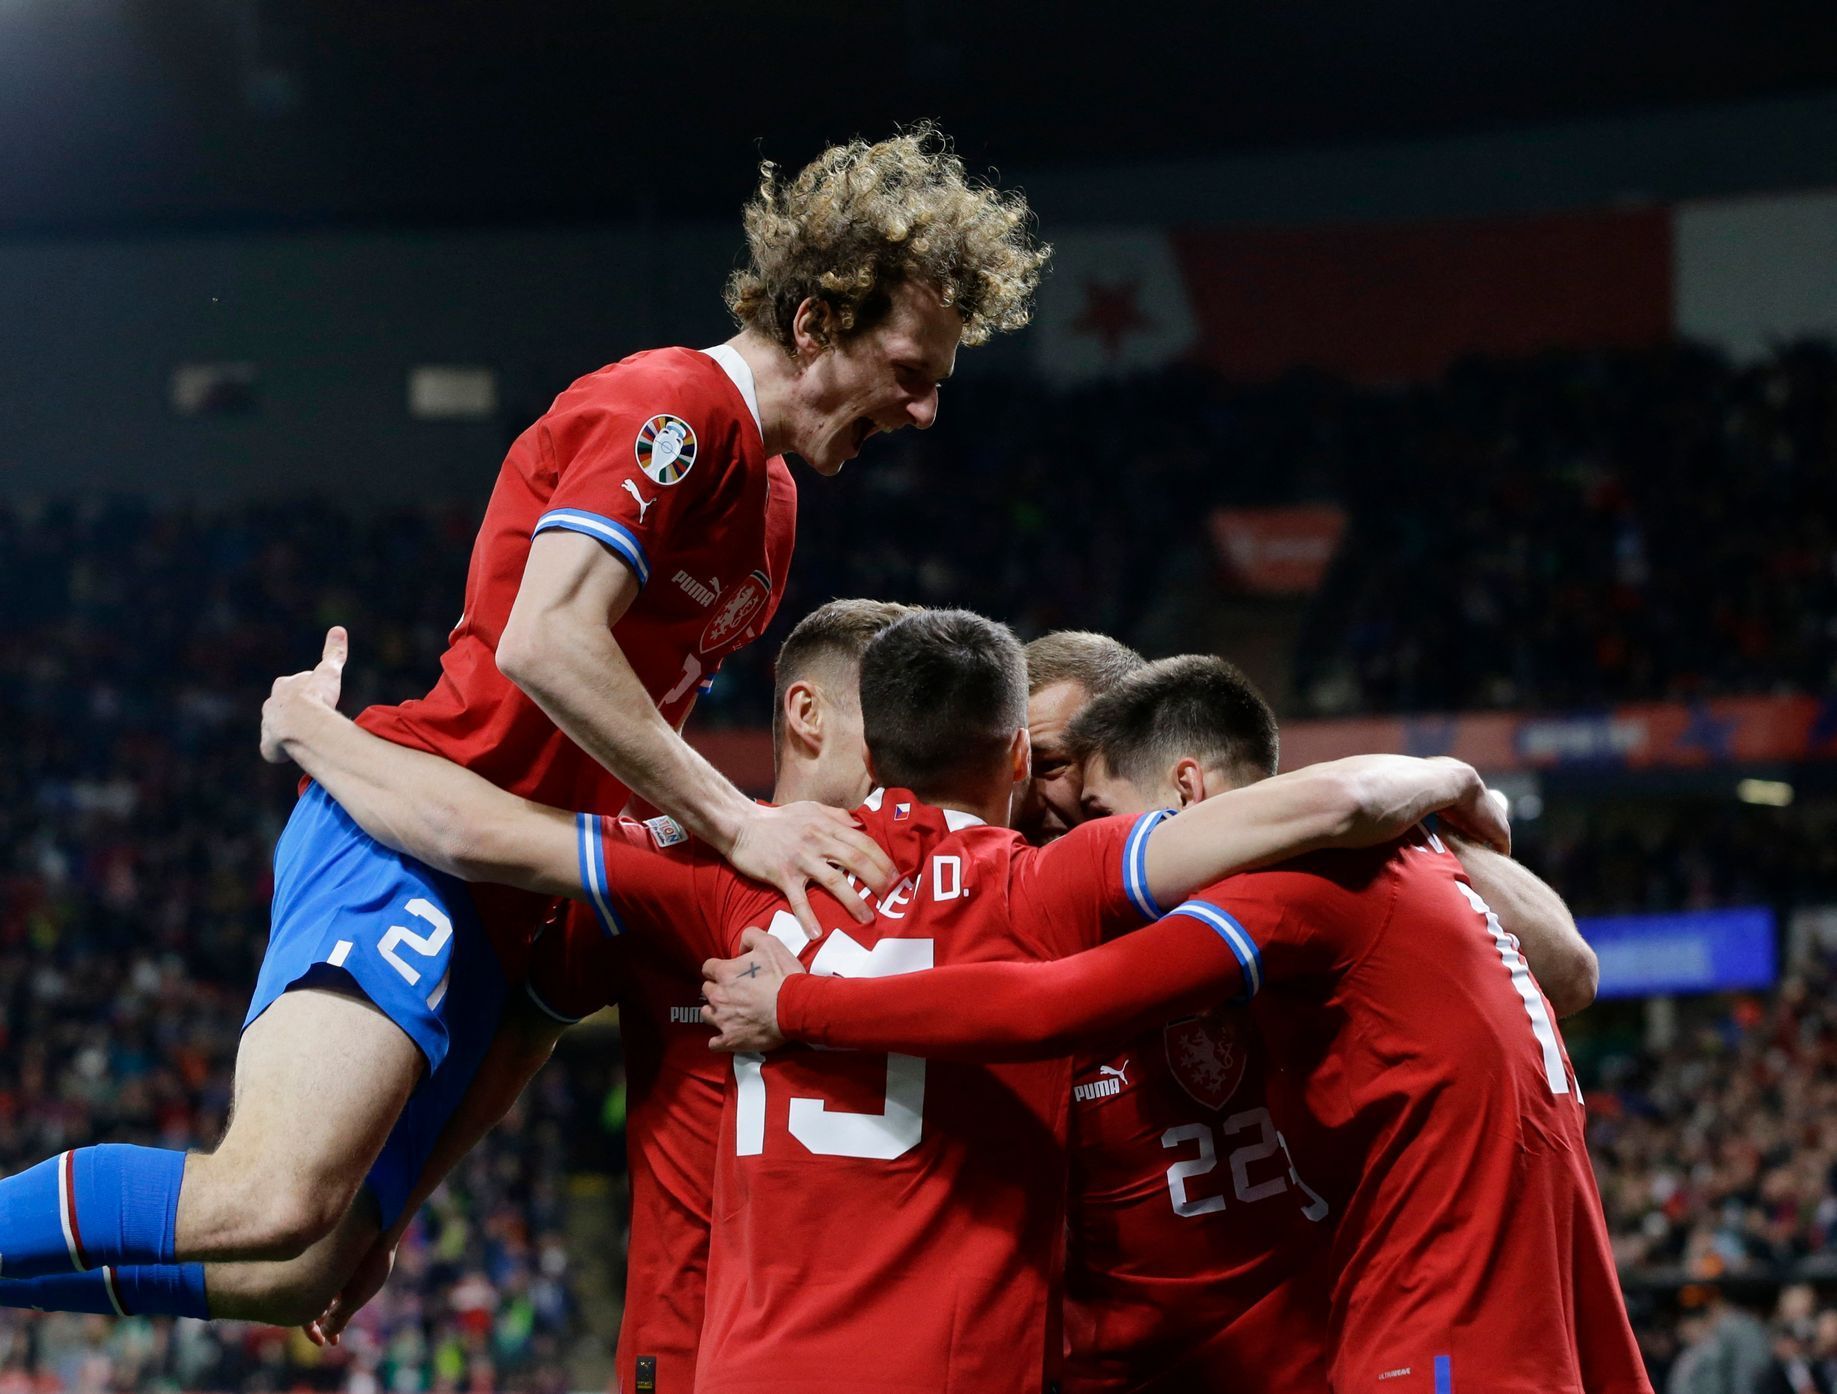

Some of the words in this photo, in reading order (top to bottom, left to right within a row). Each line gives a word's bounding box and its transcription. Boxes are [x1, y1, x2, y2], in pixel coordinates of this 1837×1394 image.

[670, 569, 716, 608] PUMA
[932, 855, 970, 902] D.
[669, 1006, 704, 1024] PUM
[1073, 1077, 1121, 1102] PUMA
[1161, 1106, 1288, 1218] 22
